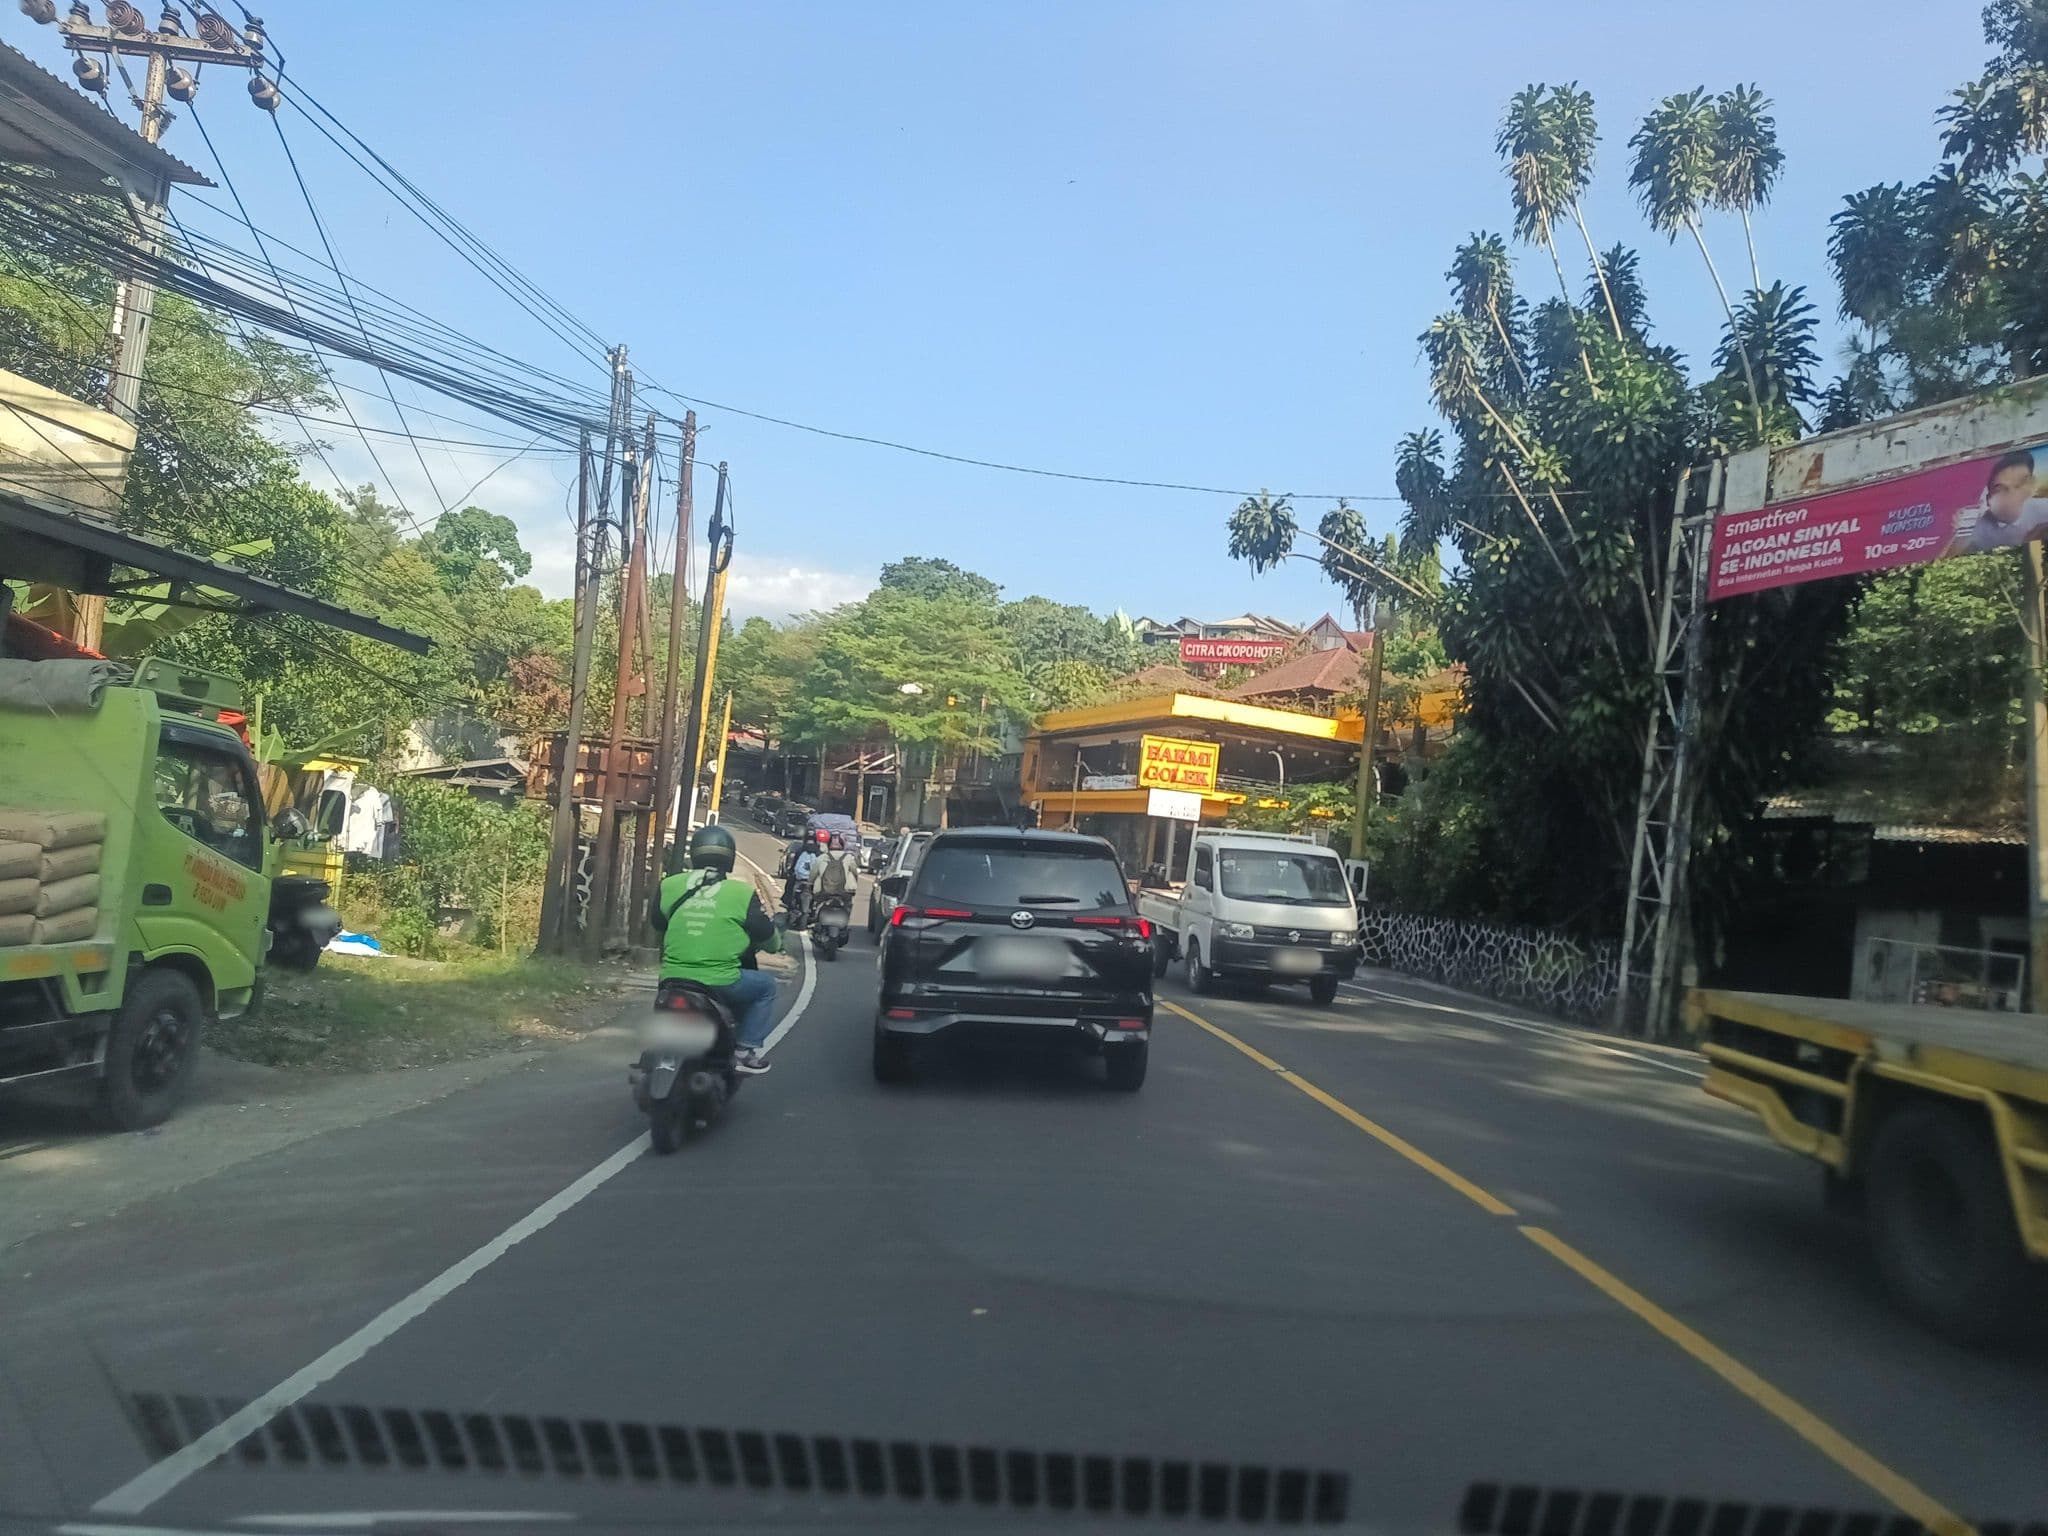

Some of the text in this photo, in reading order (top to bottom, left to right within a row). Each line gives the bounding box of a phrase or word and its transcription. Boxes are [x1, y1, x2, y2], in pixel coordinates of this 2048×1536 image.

[1725, 508, 1808, 537] smartfren
[1722, 518, 1861, 558] JAGOAN SINYAL
[1719, 538, 1842, 576] SE-INDONESIA
[1185, 643, 1215, 657] CITRA
[1216, 645, 1253, 658] CIKOPO
[1146, 744, 1213, 768] BAKMI
[1143, 765, 1210, 787] GOLEK
